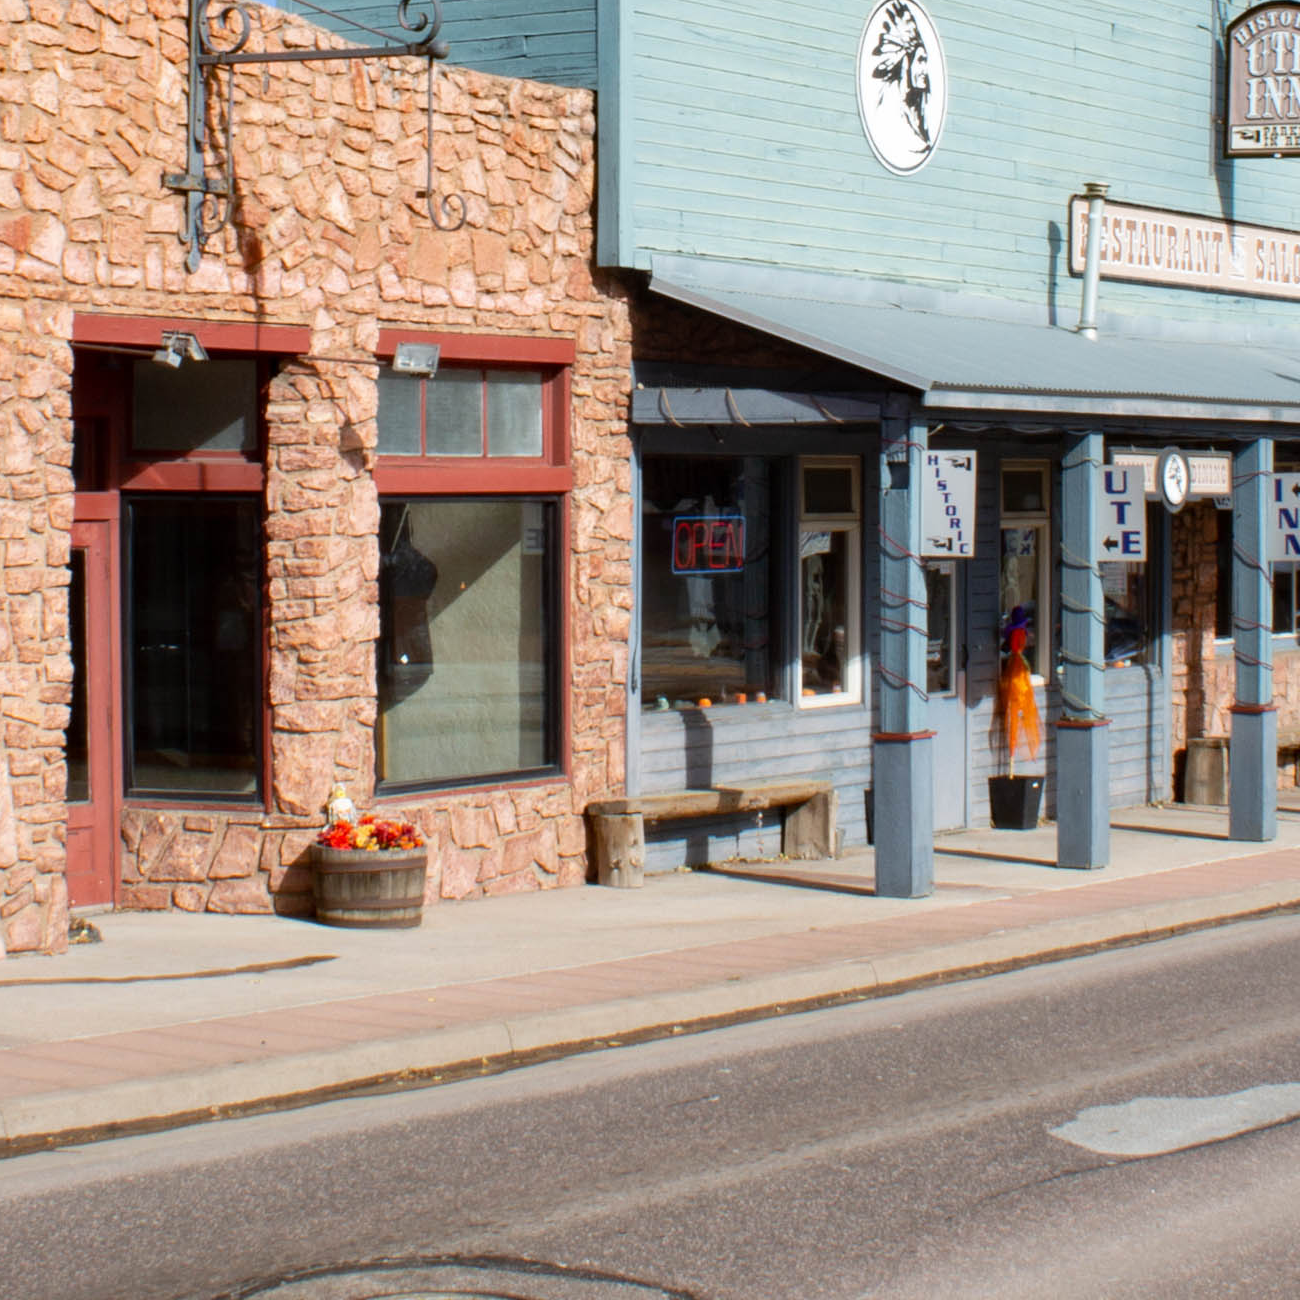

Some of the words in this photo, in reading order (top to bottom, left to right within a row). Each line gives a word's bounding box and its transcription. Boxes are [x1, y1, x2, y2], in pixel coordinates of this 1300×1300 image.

[1264, 135, 1278, 147] IN
[927, 454, 969, 555] HISTORIC
[1104, 470, 1141, 555] UTE
[673, 521, 743, 569] OPEN
